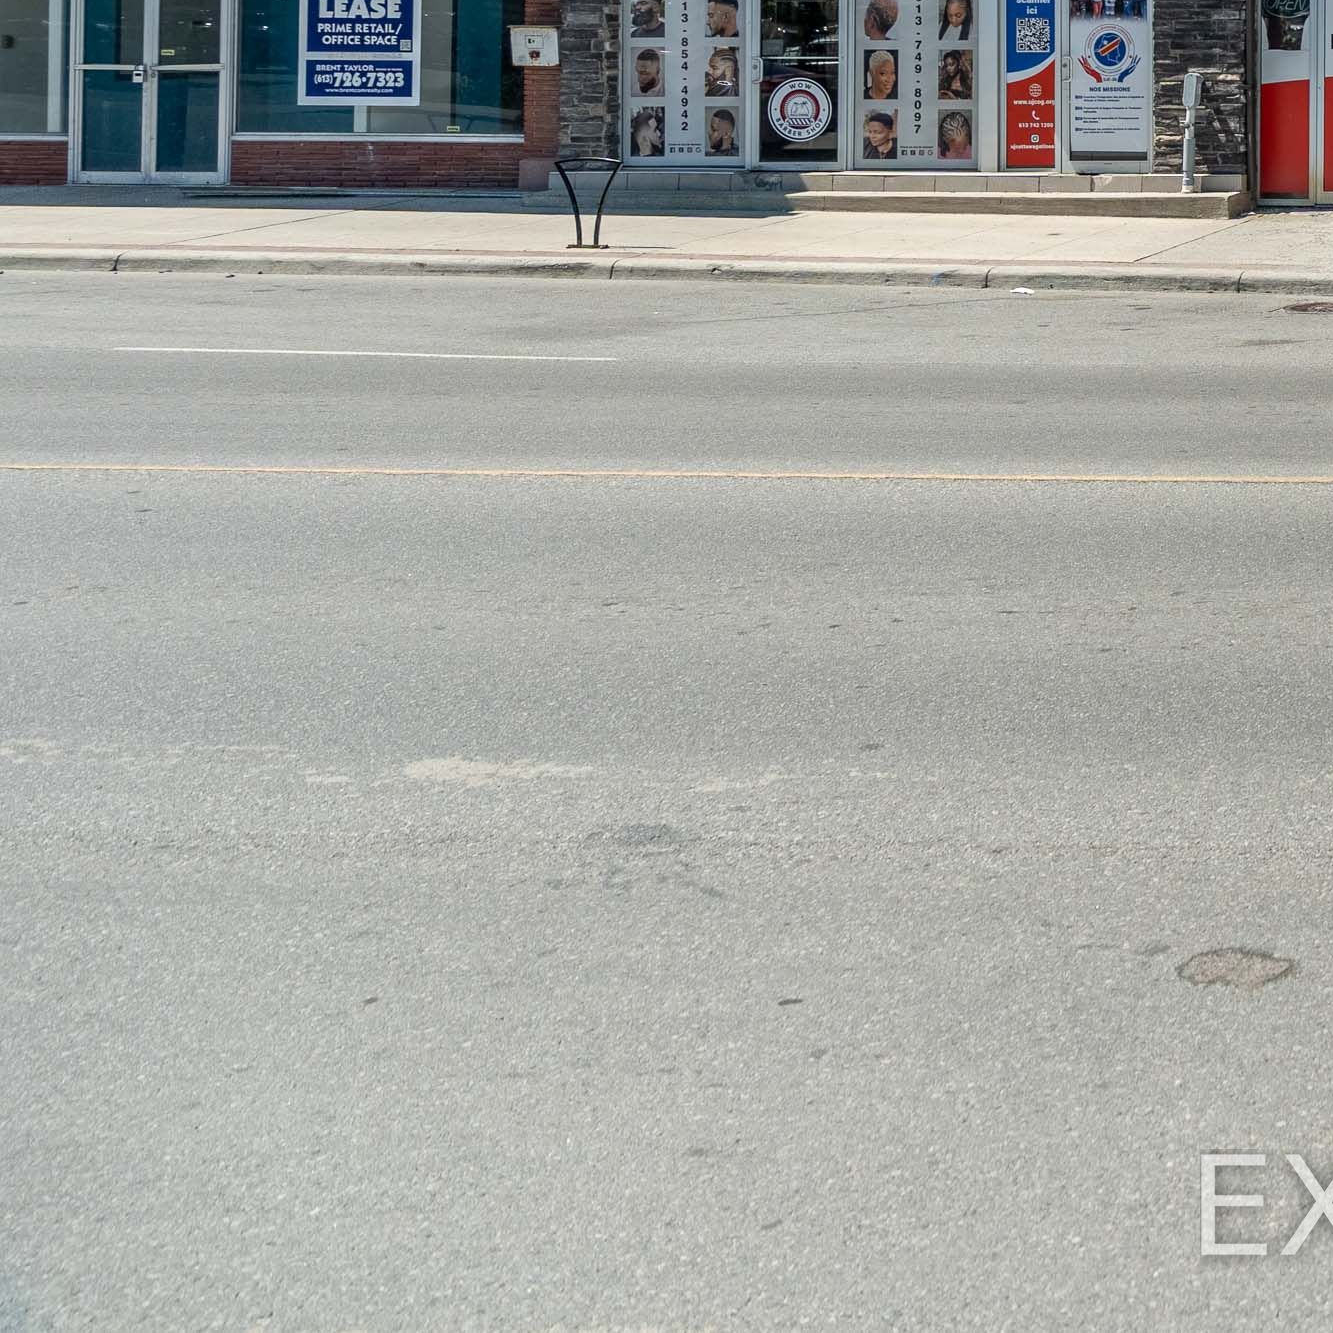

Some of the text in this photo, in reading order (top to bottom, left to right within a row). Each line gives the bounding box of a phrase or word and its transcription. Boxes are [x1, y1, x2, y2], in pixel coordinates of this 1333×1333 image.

[1026, 6, 1037, 14] ici
[317, 23, 402, 35] PRIME RETAIL/
[322, 35, 398, 45] OFFICE SPACE
[788, 82, 813, 91] WOW
[775, 117, 825, 137] BARBER SHOP
